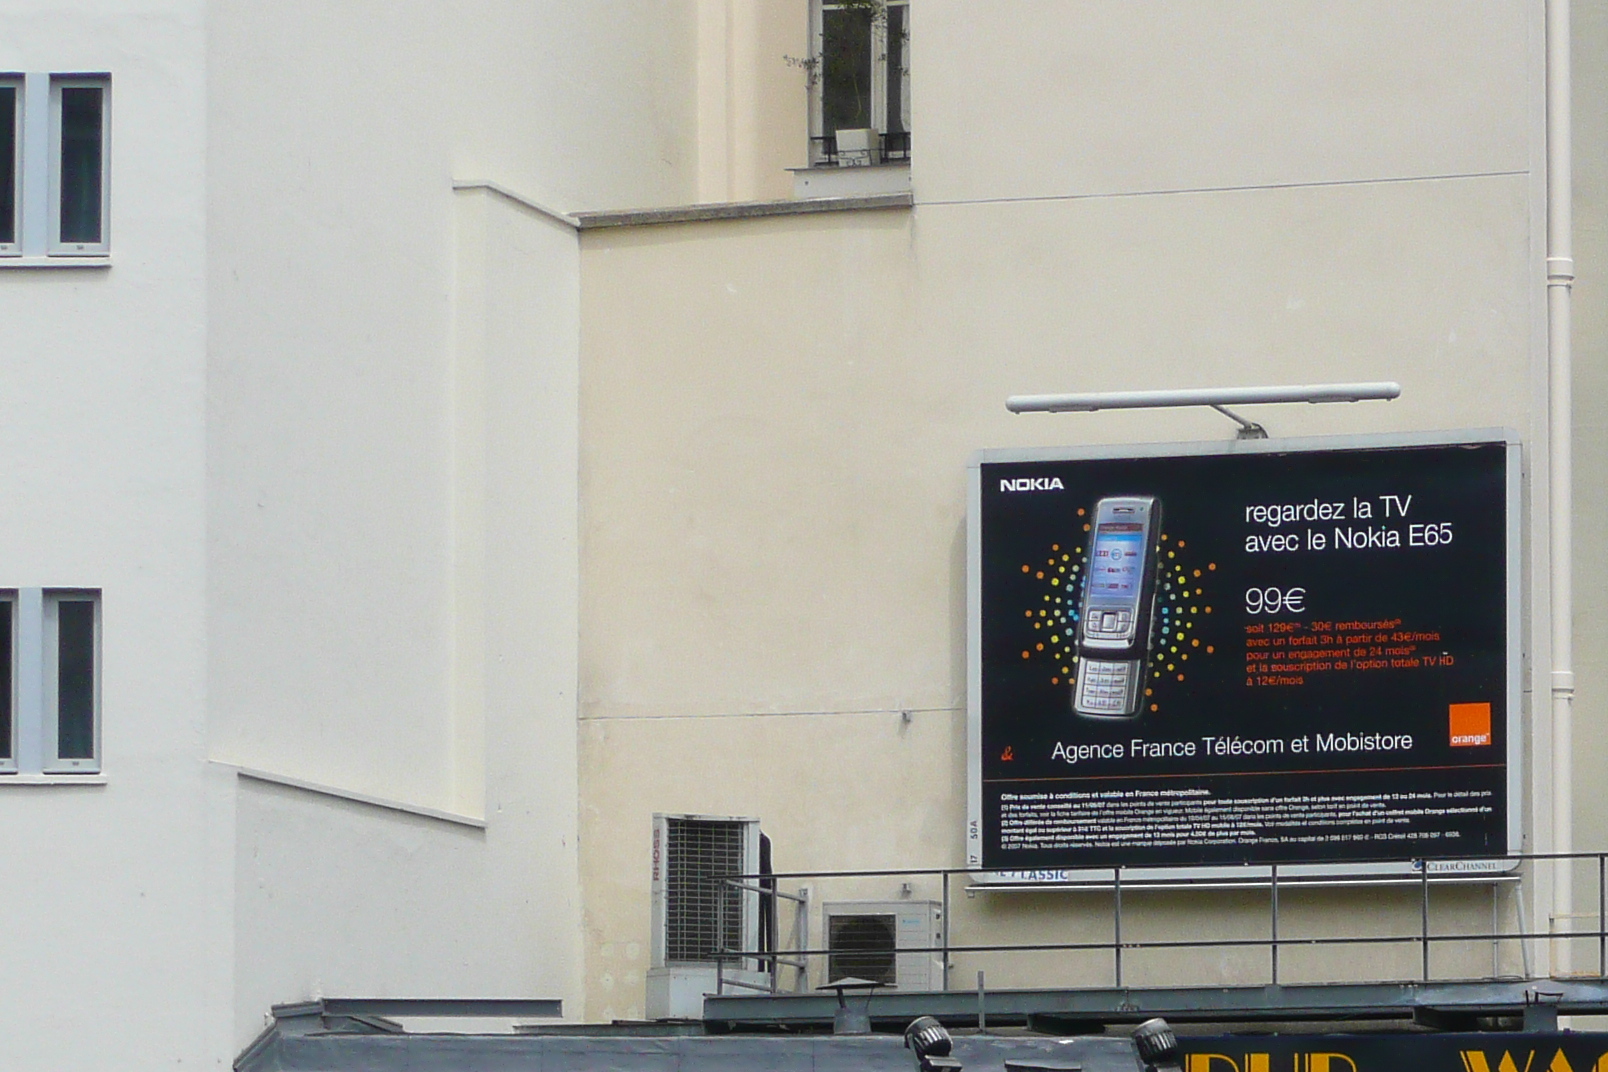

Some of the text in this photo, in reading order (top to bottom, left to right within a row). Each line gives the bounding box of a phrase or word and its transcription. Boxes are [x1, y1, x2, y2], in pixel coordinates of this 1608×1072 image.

[1000, 477, 1065, 492] NOKIA
[1245, 494, 1412, 527] regardez la TV
[1245, 522, 1453, 552] avec le Nokia E65
[1245, 587, 1306, 614] 99€
[1246, 631, 1440, 647] avec un forfait 3h à partir de 43€/mois
[1246, 652, 1269, 661] pour
[1272, 651, 1285, 659] un
[1288, 648, 1350, 660] engagement
[1354, 647, 1367, 657] de
[1369, 646, 1382, 656] 24
[1246, 664, 1256, 673] et
[1259, 663, 1268, 672] la
[1271, 661, 1332, 672] souscription
[1334, 660, 1347, 670] de
[1391, 657, 1420, 668] totale
[1422, 656, 1437, 666] TV
[1439, 655, 1454, 666] HD
[1246, 675, 1304, 686] à 12€/mois
[1452, 732, 1487, 745] orange
[1051, 732, 1413, 764] Agence France Télécom et Mobistore
[970, 820, 978, 840] 50A
